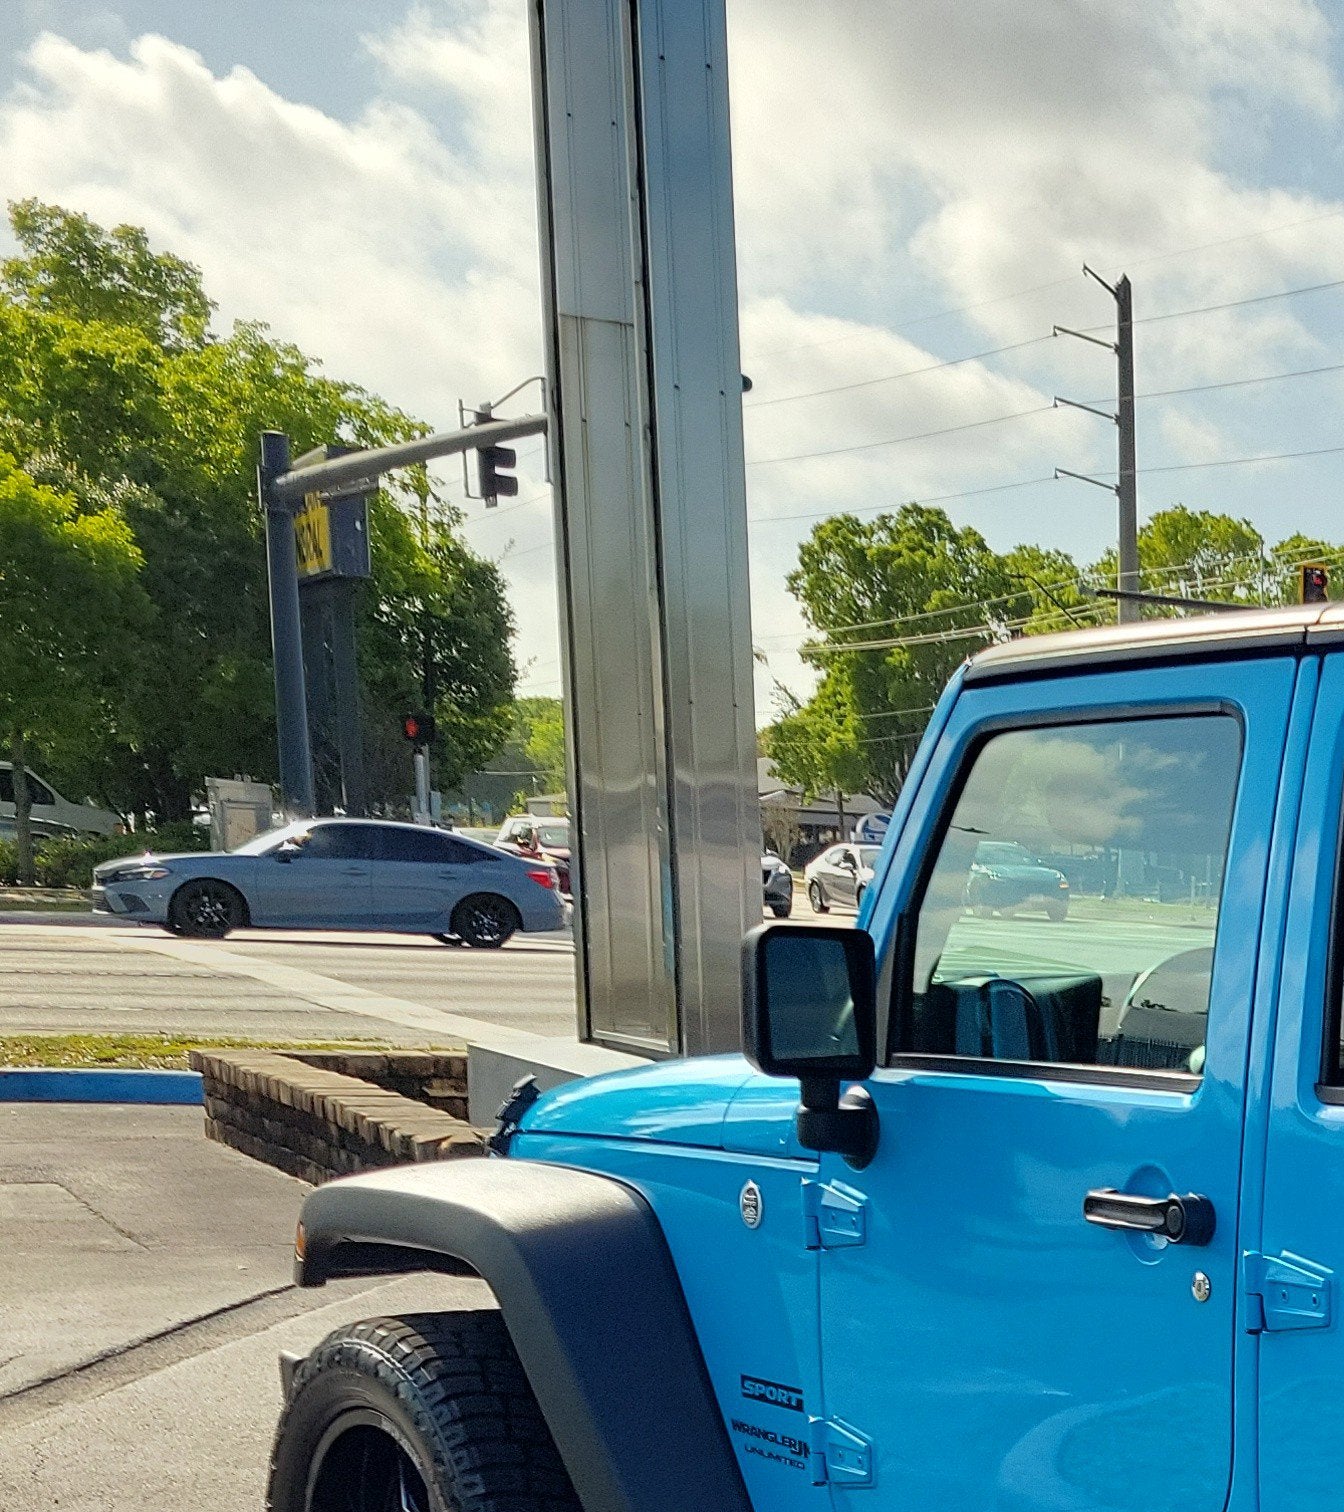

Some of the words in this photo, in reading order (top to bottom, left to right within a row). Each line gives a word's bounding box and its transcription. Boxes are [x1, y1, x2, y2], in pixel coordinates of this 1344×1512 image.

[743, 1380, 800, 1407] SPORT
[731, 1418, 797, 1449] WRANGLER
[744, 1443, 806, 1470] UNLIMITED
